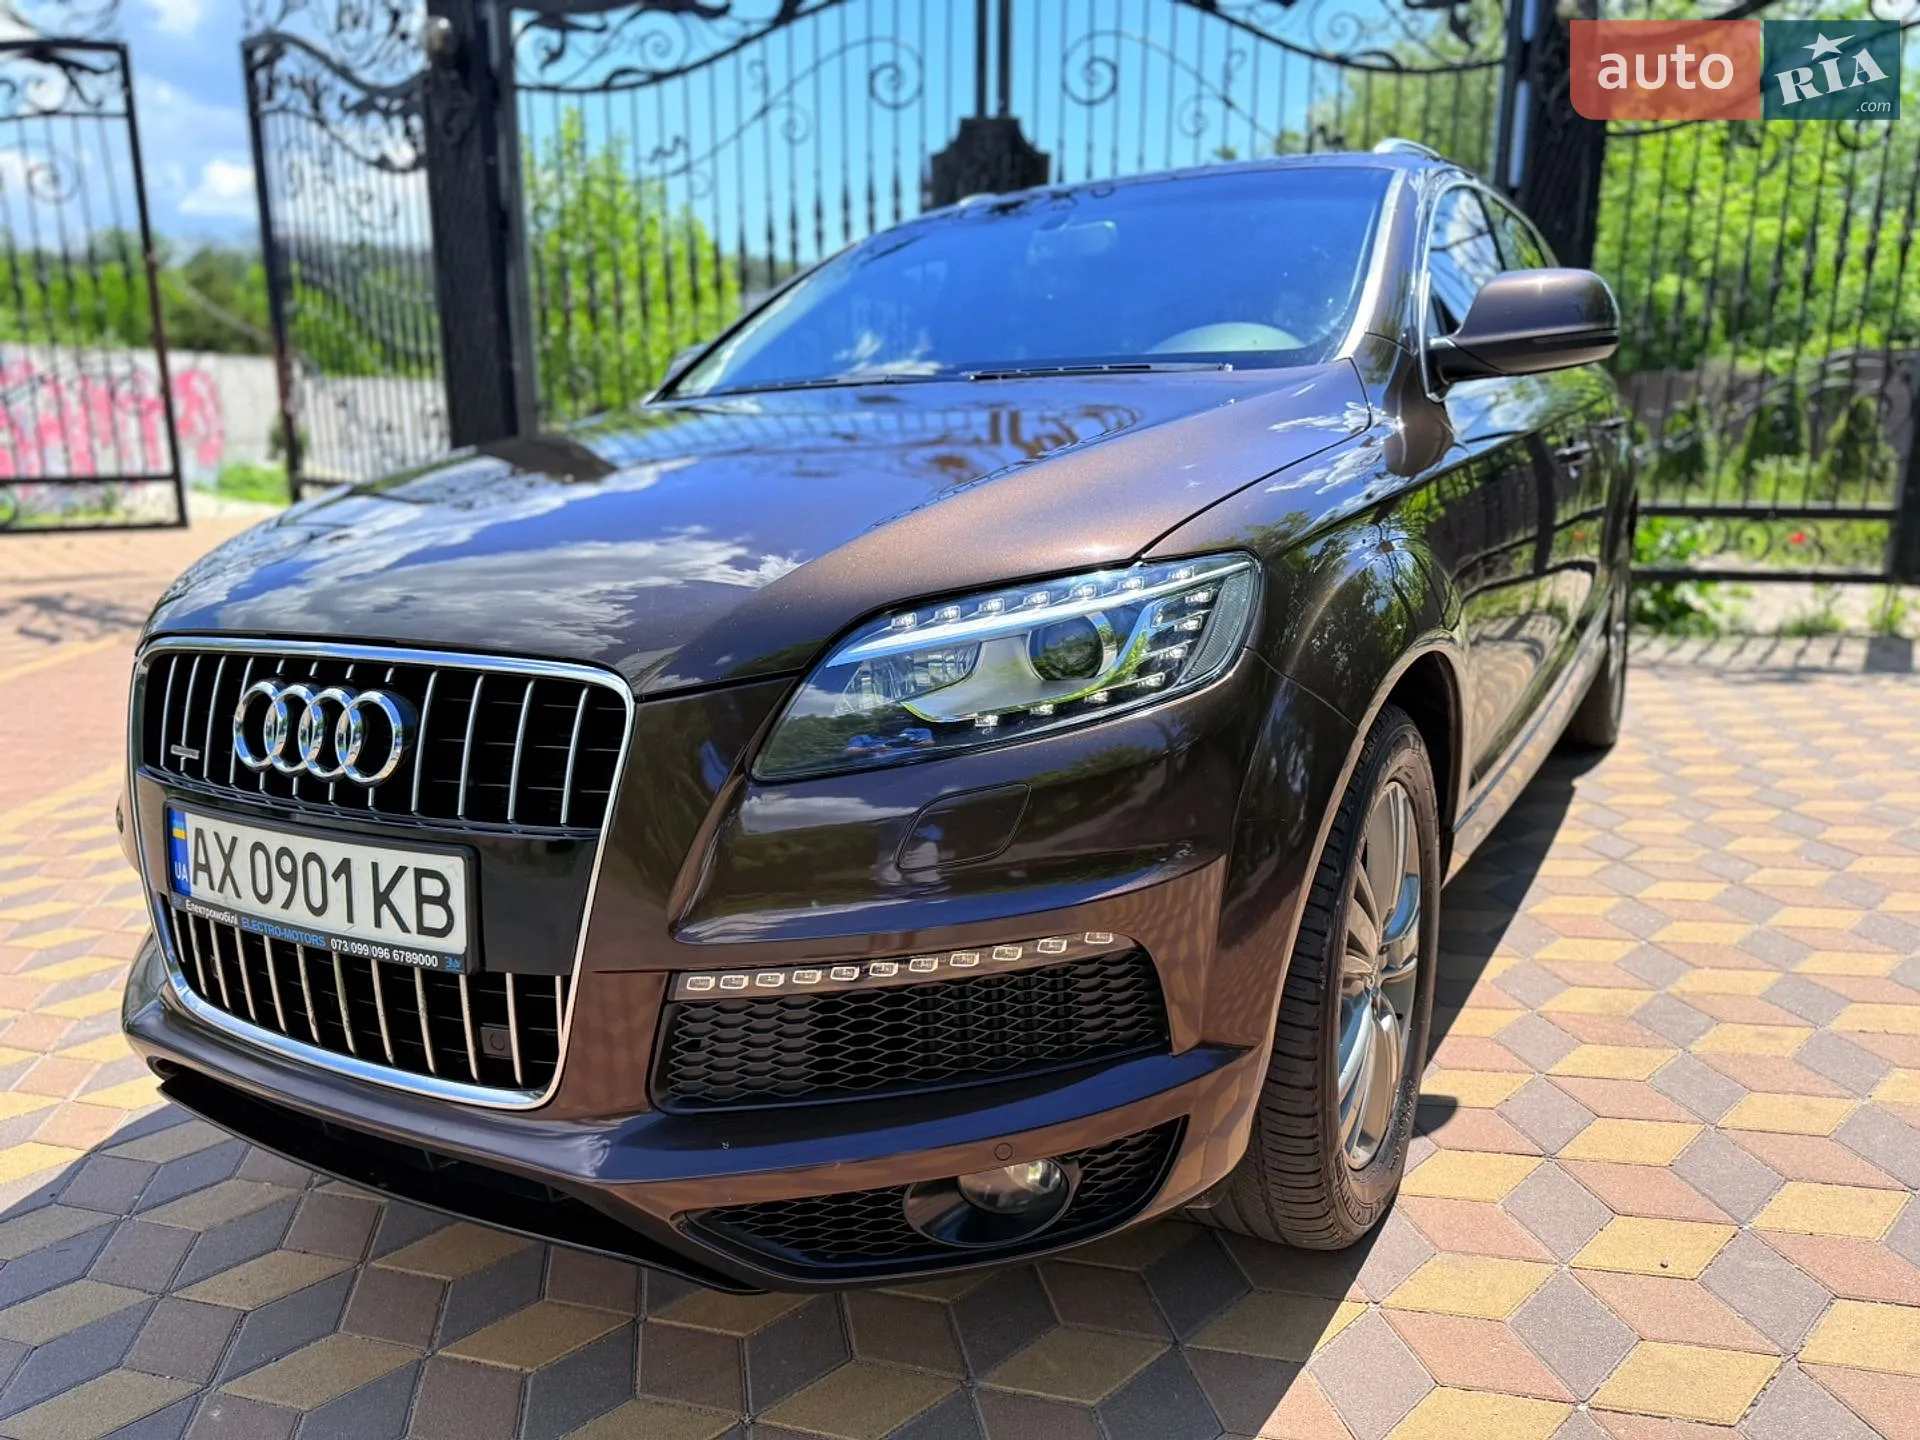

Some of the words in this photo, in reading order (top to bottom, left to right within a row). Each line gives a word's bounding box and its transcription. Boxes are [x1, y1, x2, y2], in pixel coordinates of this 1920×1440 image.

[174, 861, 188, 883] UA
[192, 827, 242, 899] AX
[250, 841, 355, 924] 0901
[371, 861, 455, 939] KB
[241, 917, 326, 947] ELECTRO-MOTORS
[392, 949, 439, 967] 6789000
